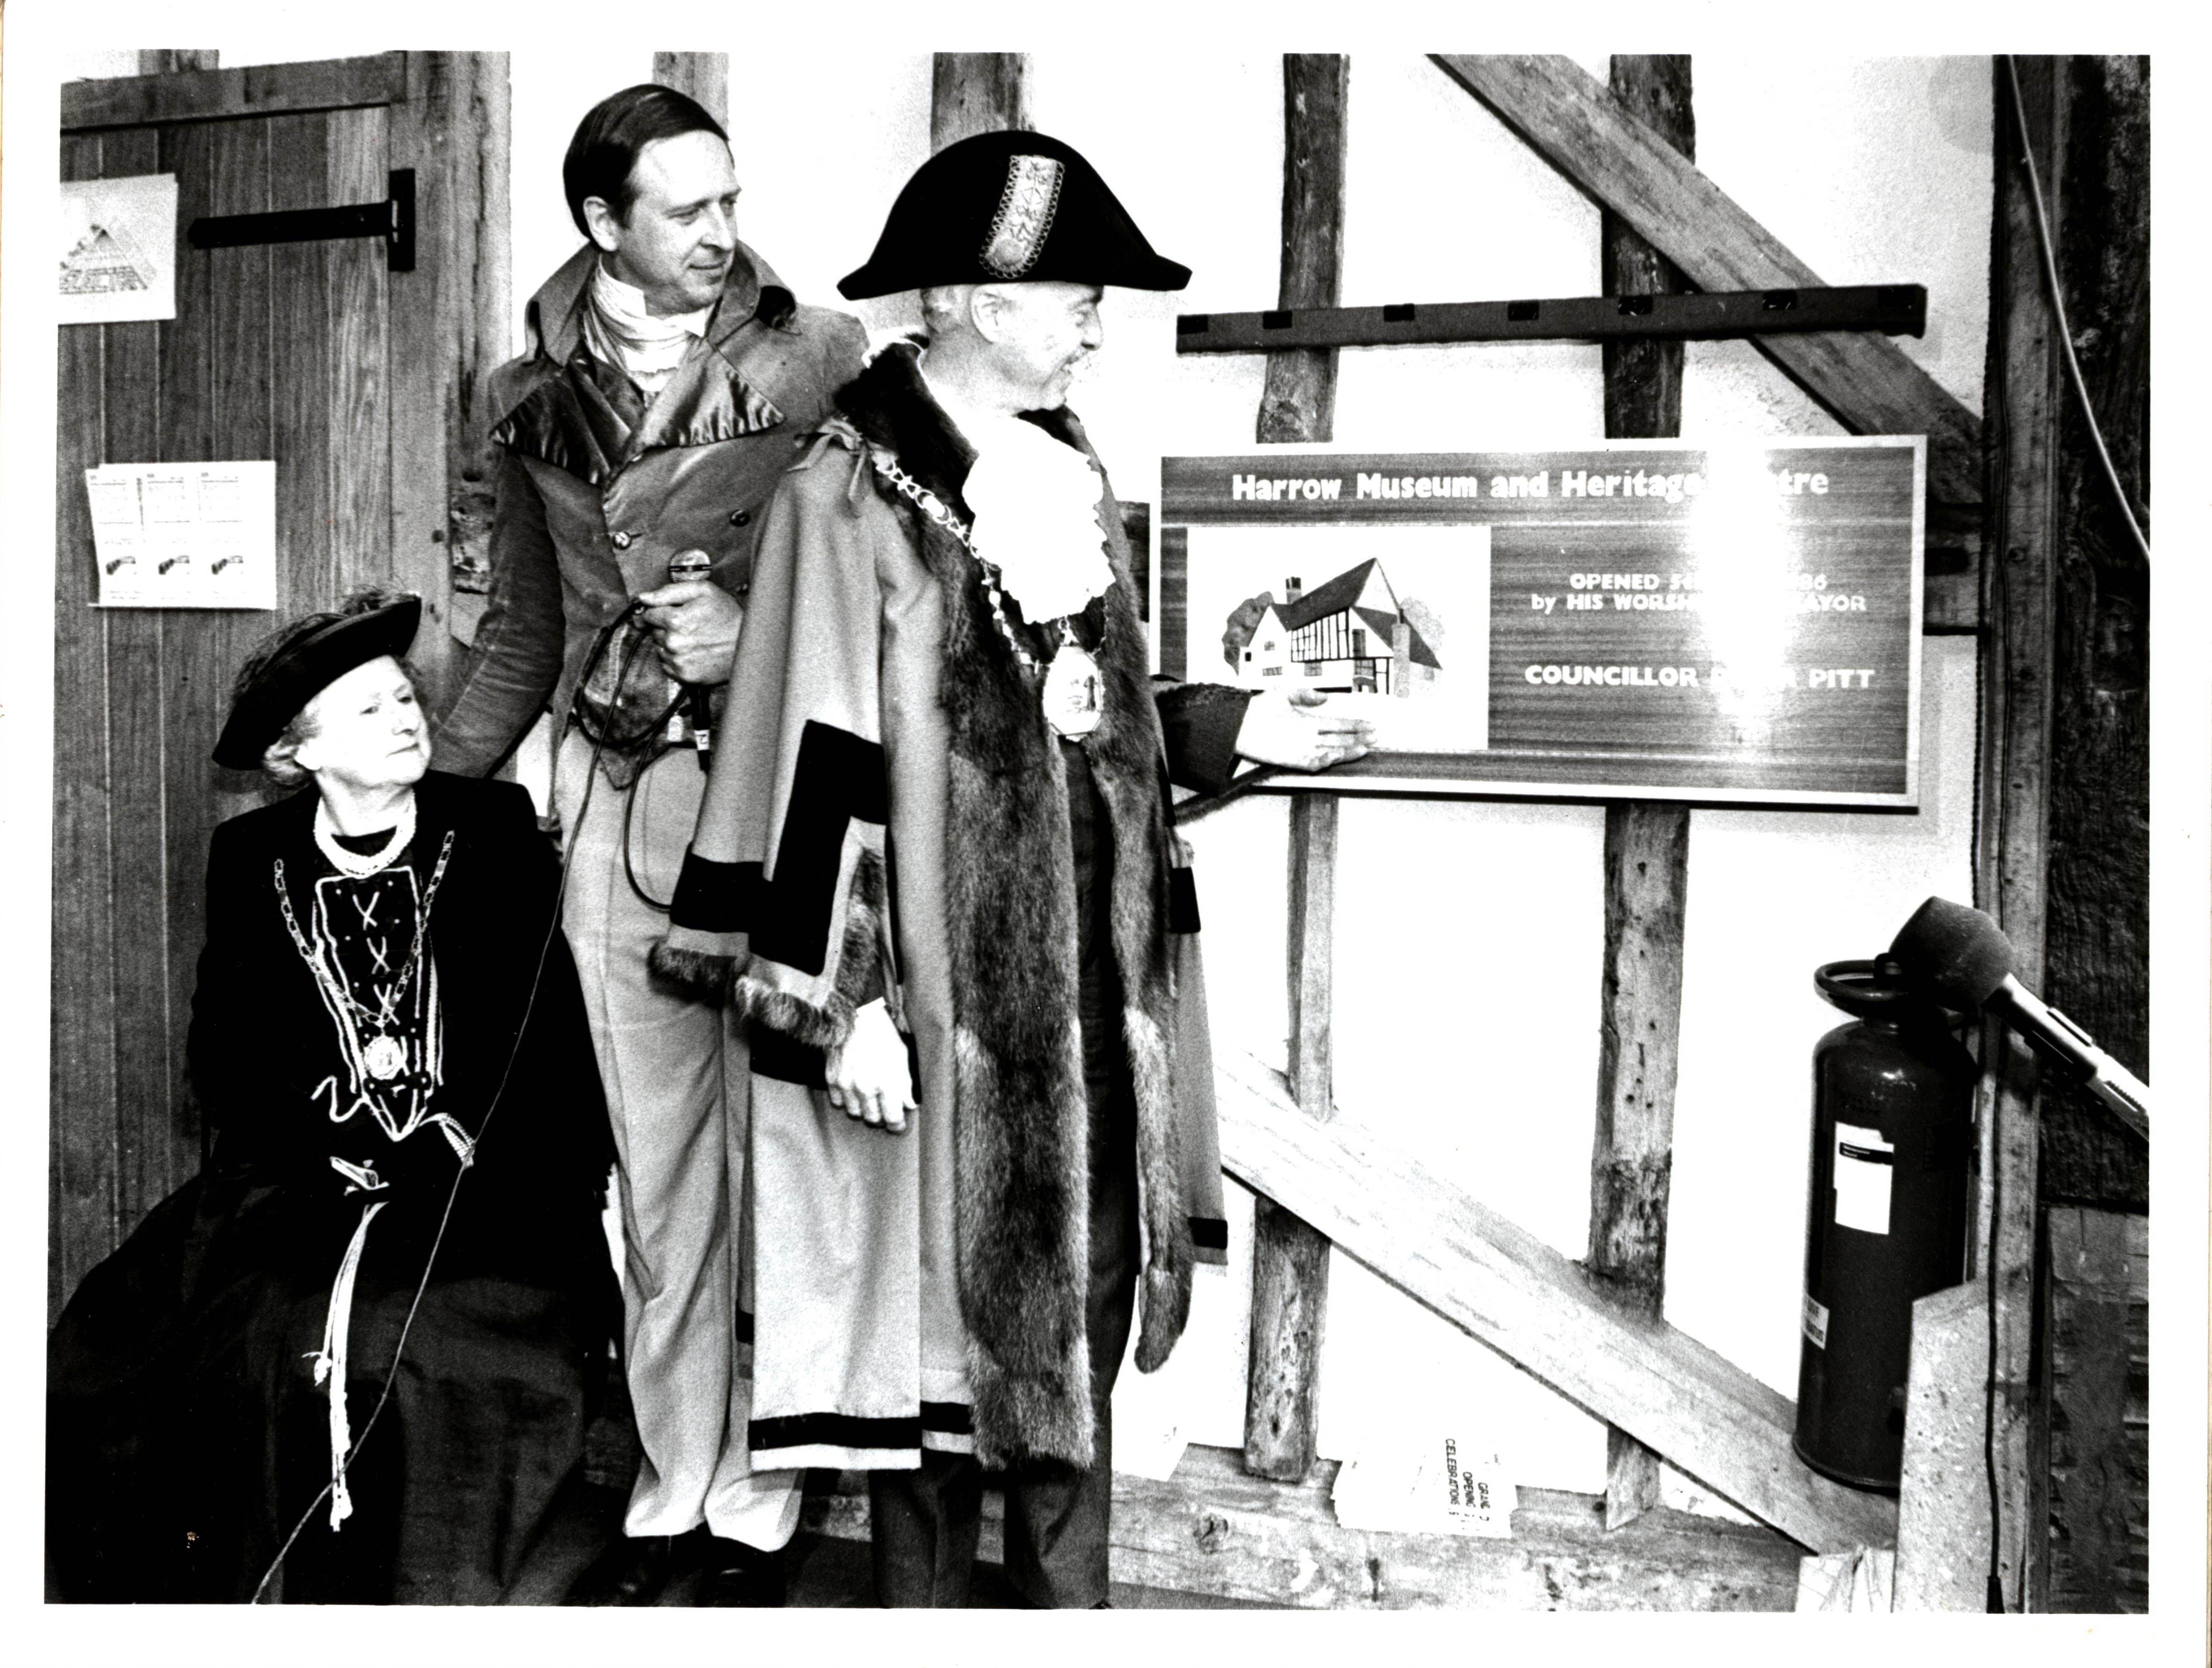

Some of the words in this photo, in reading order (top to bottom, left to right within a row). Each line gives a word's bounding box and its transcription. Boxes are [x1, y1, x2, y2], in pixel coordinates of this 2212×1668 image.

[1233, 475, 1342, 500] Harrow
[1357, 473, 1477, 499] Museum
[1491, 471, 1549, 498] and
[1570, 573, 1660, 590] OPENED
[1532, 594, 1556, 614] by
[1567, 594, 1604, 610] HIS
[1614, 594, 1693, 611] WORSH
[1798, 594, 1867, 612] AYOR
[1525, 665, 1699, 687] COUNCILLOR
[1809, 669, 1876, 688] PITT
